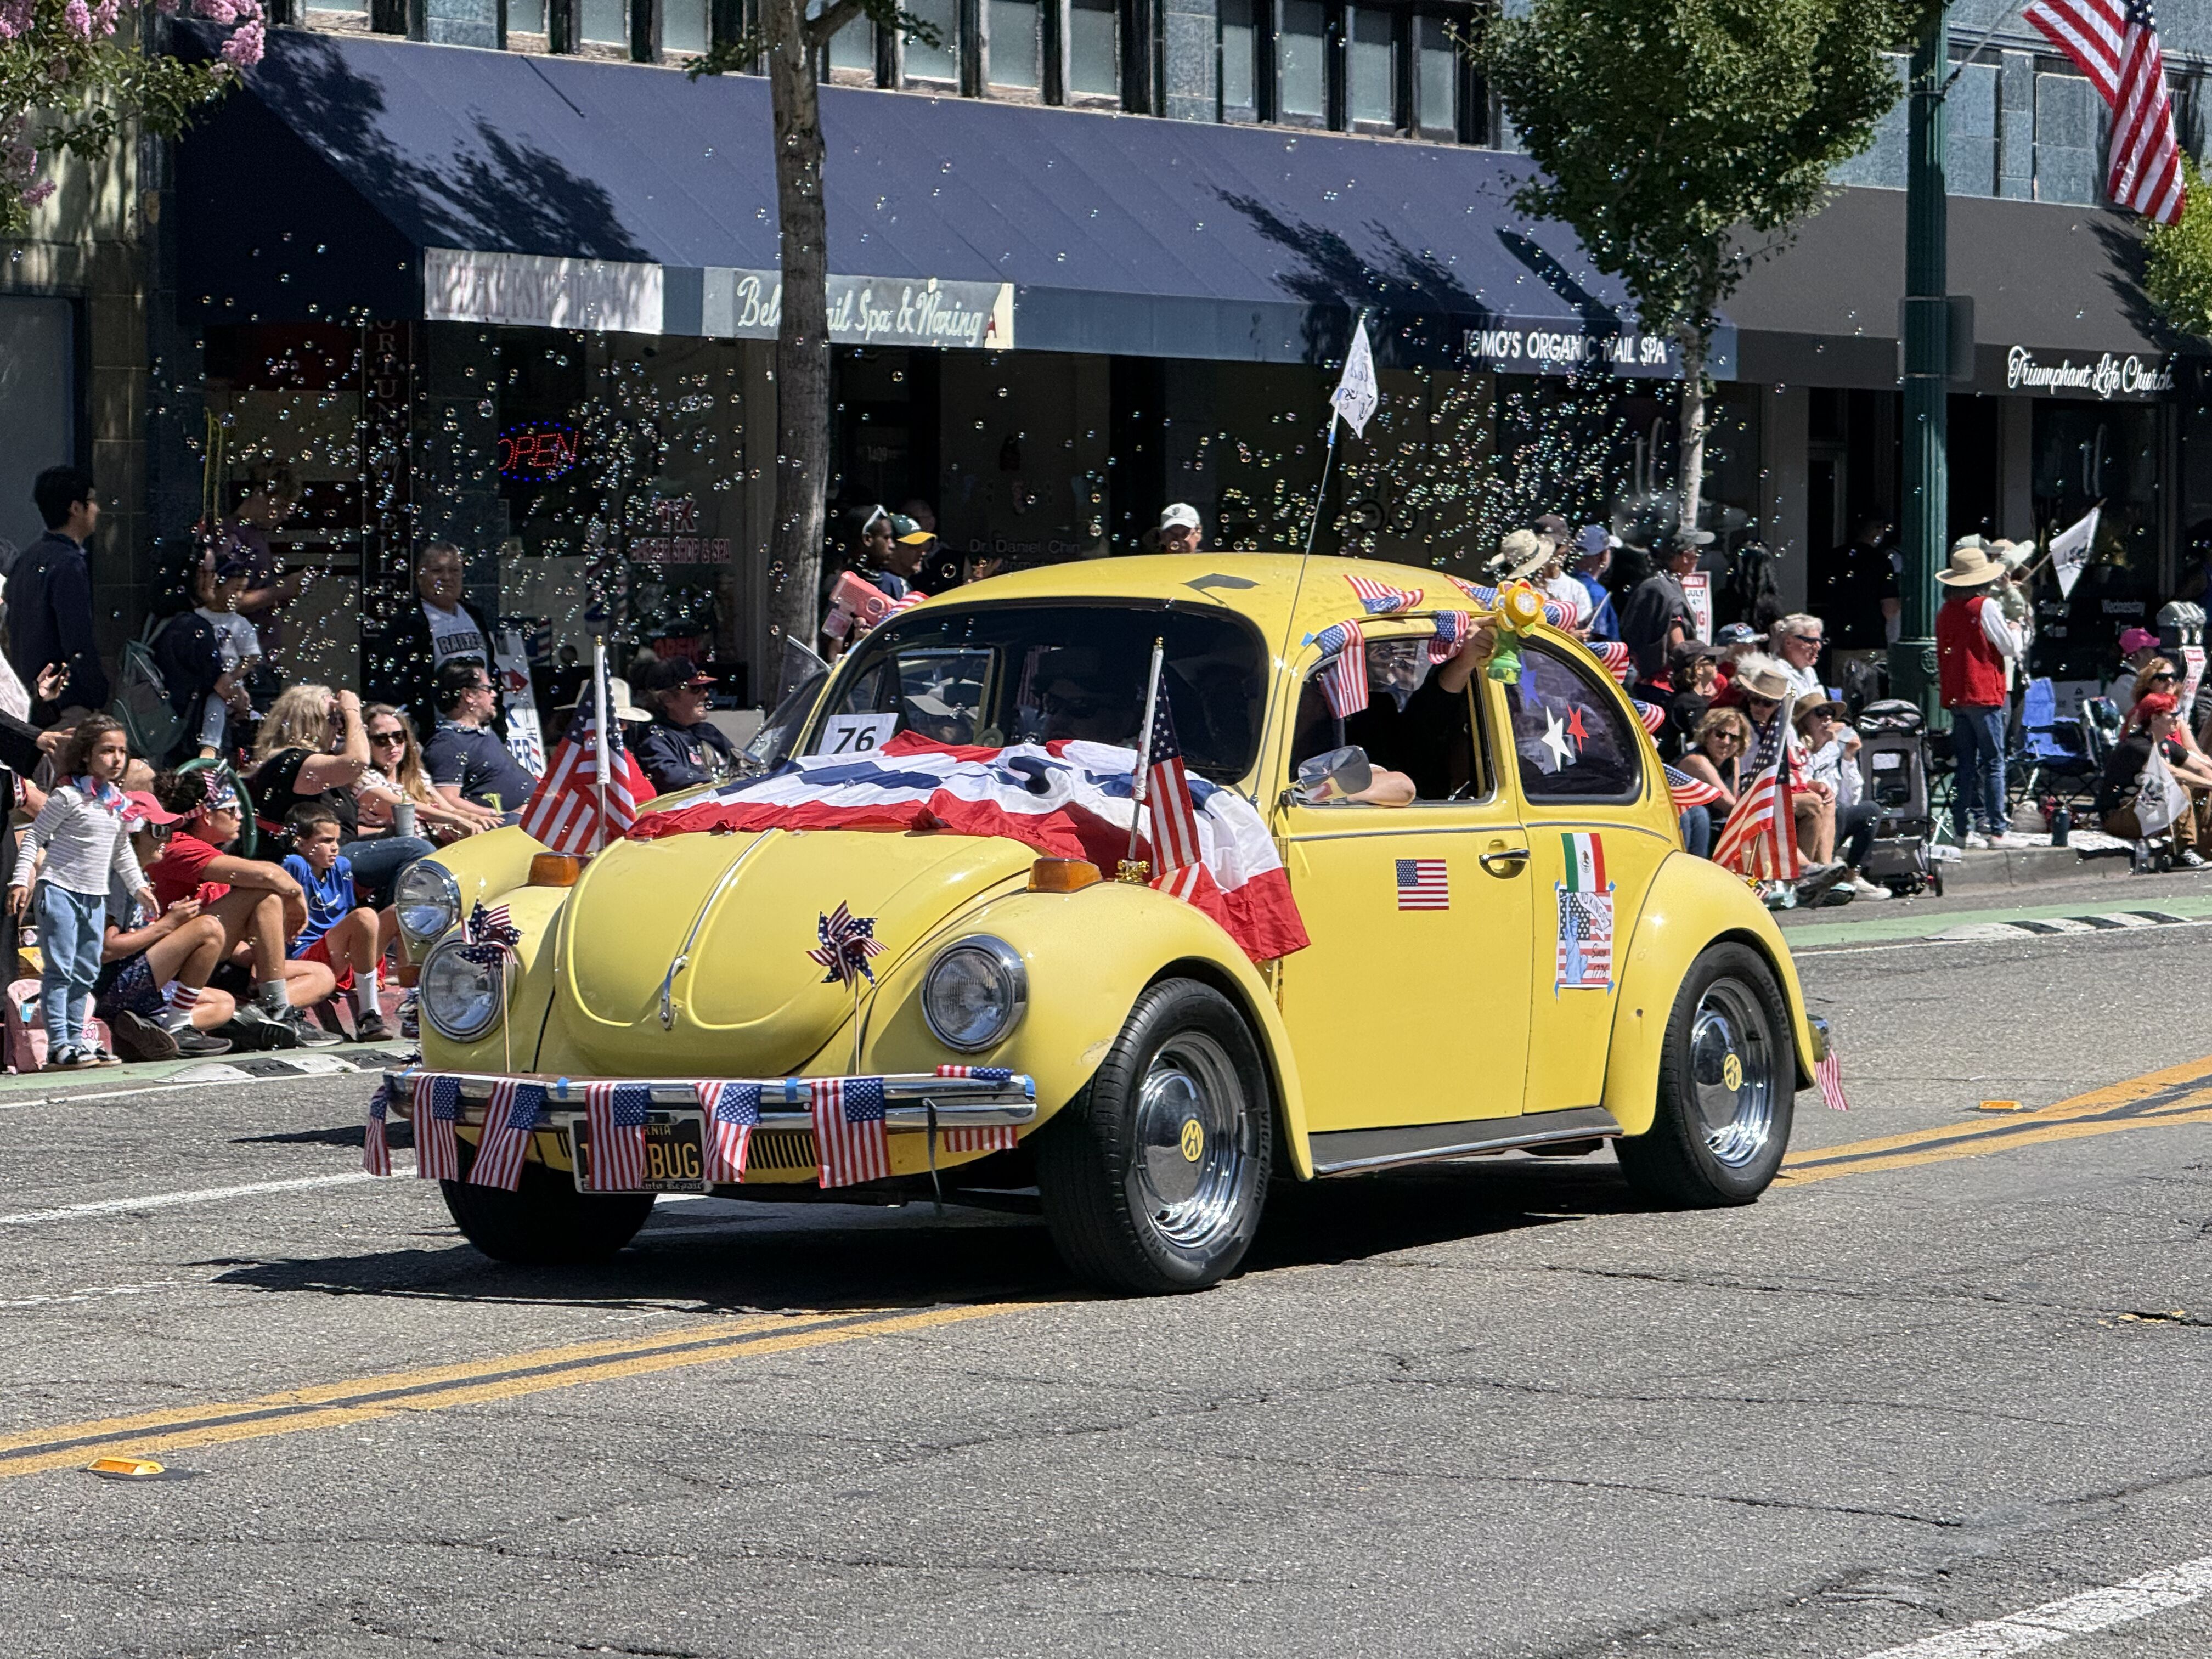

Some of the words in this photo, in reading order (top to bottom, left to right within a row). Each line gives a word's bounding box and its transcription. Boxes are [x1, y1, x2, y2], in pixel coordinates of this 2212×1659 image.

[737, 276, 782, 328] Bel
[854, 289, 892, 341] Spa
[896, 286, 915, 333] &
[916, 290, 984, 347] Waxing
[1463, 329, 1522, 358] TOMO'S
[1527, 331, 1598, 362] ORGANIC
[1602, 336, 1636, 363] NAIL
[1640, 336, 1667, 363] SPA
[2008, 346, 2093, 395] Triumphant
[2092, 353, 2120, 399] Life
[2123, 356, 2174, 393] Church
[672, 538, 699, 565] SHOP
[712, 538, 731, 564] SPA
[996, 539, 1041, 554] Daniel
[832, 726, 877, 755] 76
[1589, 896, 1607, 923] KINGS
